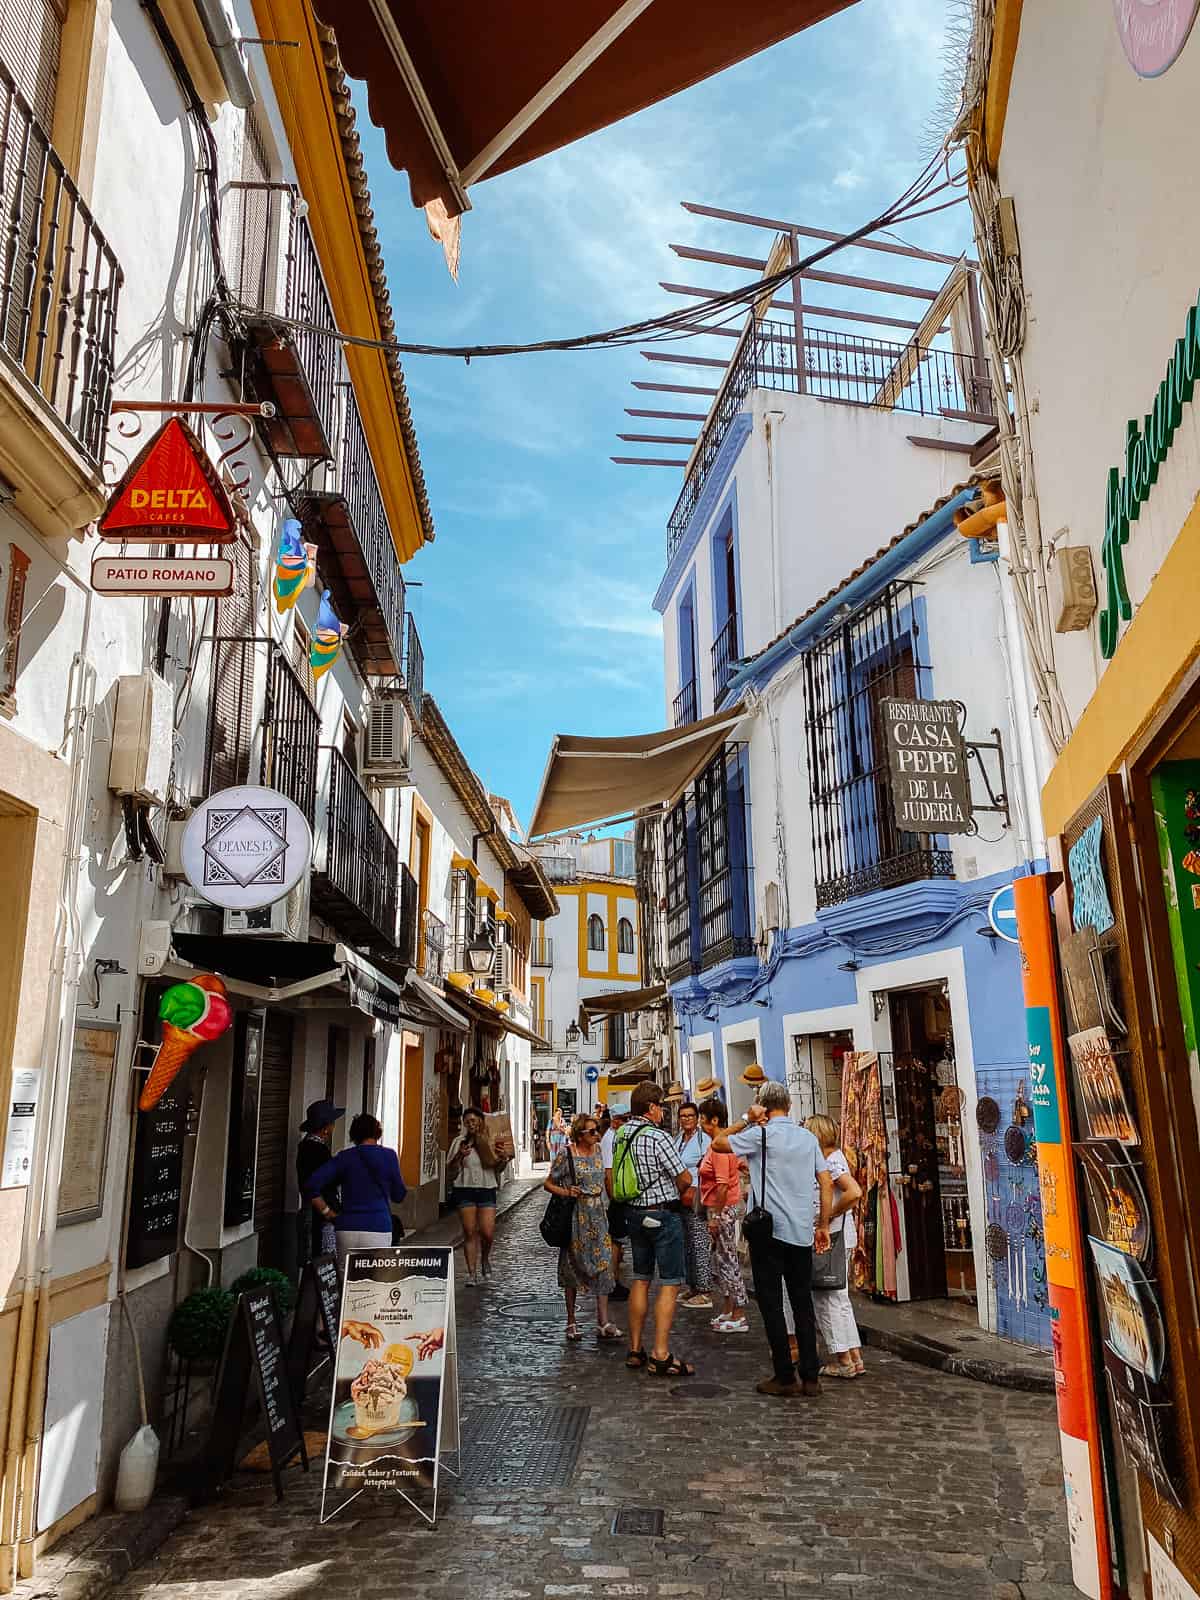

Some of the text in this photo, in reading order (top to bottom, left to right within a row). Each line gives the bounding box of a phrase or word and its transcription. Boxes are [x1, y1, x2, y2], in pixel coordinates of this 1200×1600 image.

[130, 487, 208, 509] DELTA
[106, 568, 216, 581] PATIO ROMANO
[887, 702, 954, 723] RESTAURANTE
[893, 722, 955, 748] CASA
[896, 749, 958, 775] PEPE
[908, 779, 953, 800] DE LA
[354, 1257, 441, 1269] HELADOS PREMIUM
